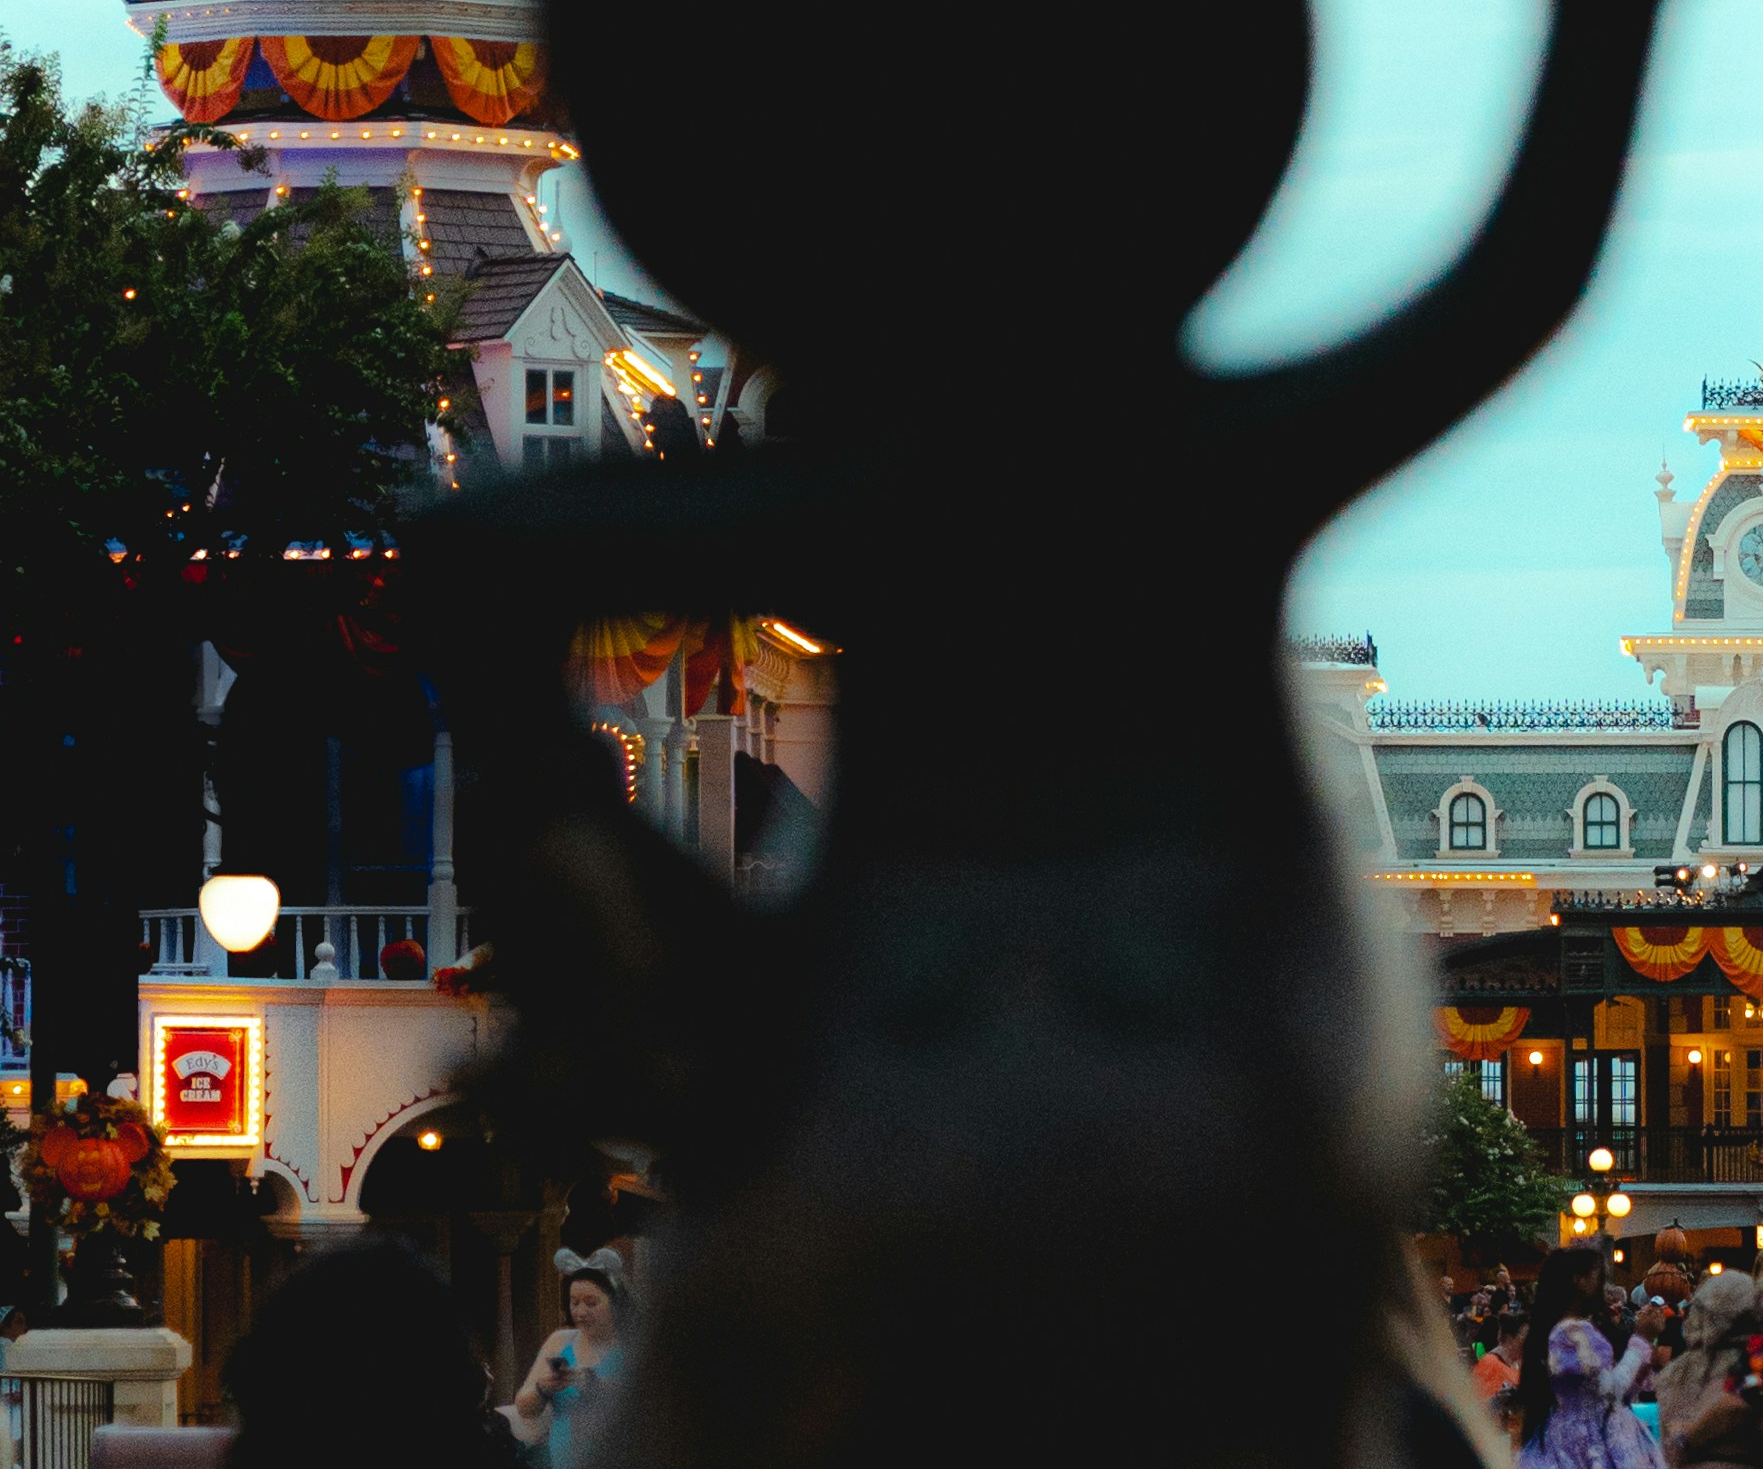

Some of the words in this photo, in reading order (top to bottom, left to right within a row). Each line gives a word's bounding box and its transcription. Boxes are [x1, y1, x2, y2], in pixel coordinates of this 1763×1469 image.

[186, 1054, 219, 1071] Edy's
[191, 1077, 210, 1088] ICE
[180, 1090, 221, 1102] CREAM
